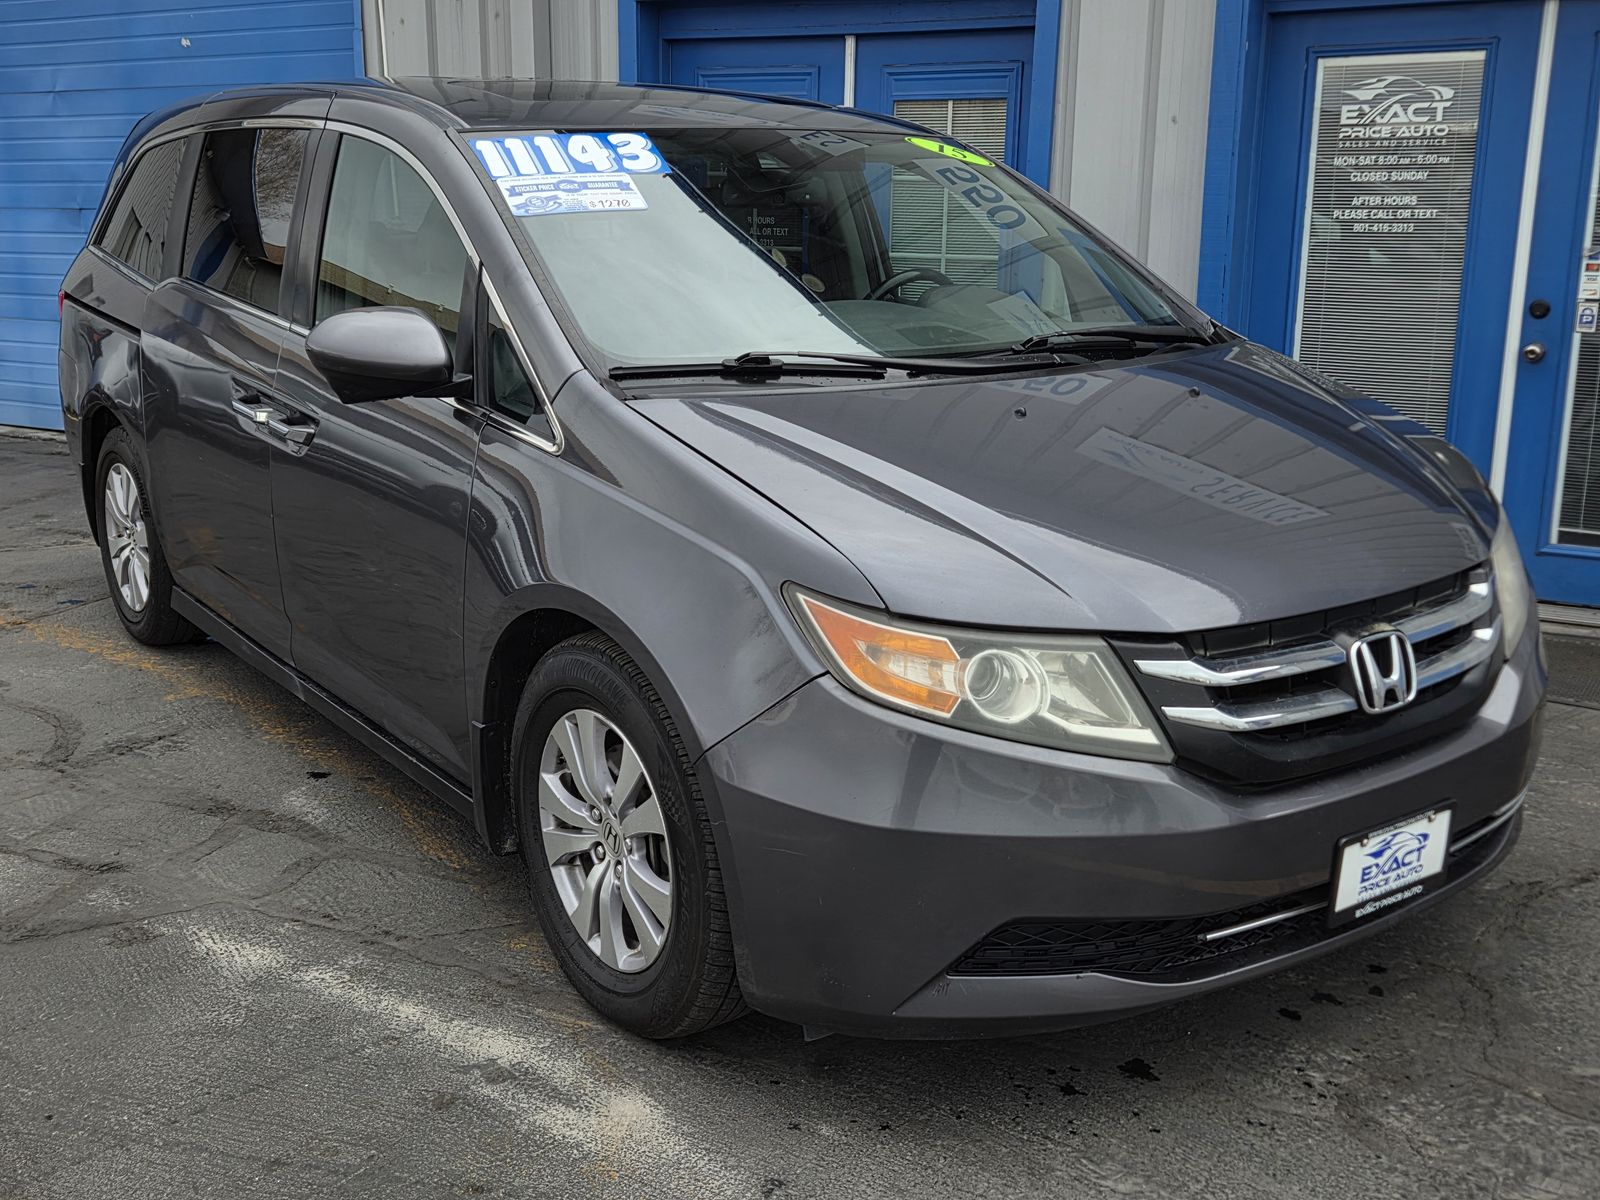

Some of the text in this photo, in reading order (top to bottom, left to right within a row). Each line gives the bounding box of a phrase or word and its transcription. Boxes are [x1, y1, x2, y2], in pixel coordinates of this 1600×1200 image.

[1340, 101, 1453, 125] EXACT
[1339, 124, 1450, 139] PRICE AUTO
[1339, 138, 1448, 148] SALES AND SERVICE
[475, 133, 661, 177] 11143
[1350, 170, 1429, 182] CLOSED SUNDAY
[514, 184, 539, 193] STICKER
[539, 183, 555, 191] PRICE
[1352, 195, 1418, 206] AFTER HOURS
[1333, 209, 1439, 219] PLEASE CALL OR TEXT
[773, 227, 789, 236] TEXT
[1360, 844, 1427, 884] EXACT
[1358, 875, 1393, 895] PRICE
[1394, 864, 1424, 881] AUTO
[1403, 885, 1424, 899] AUTO
